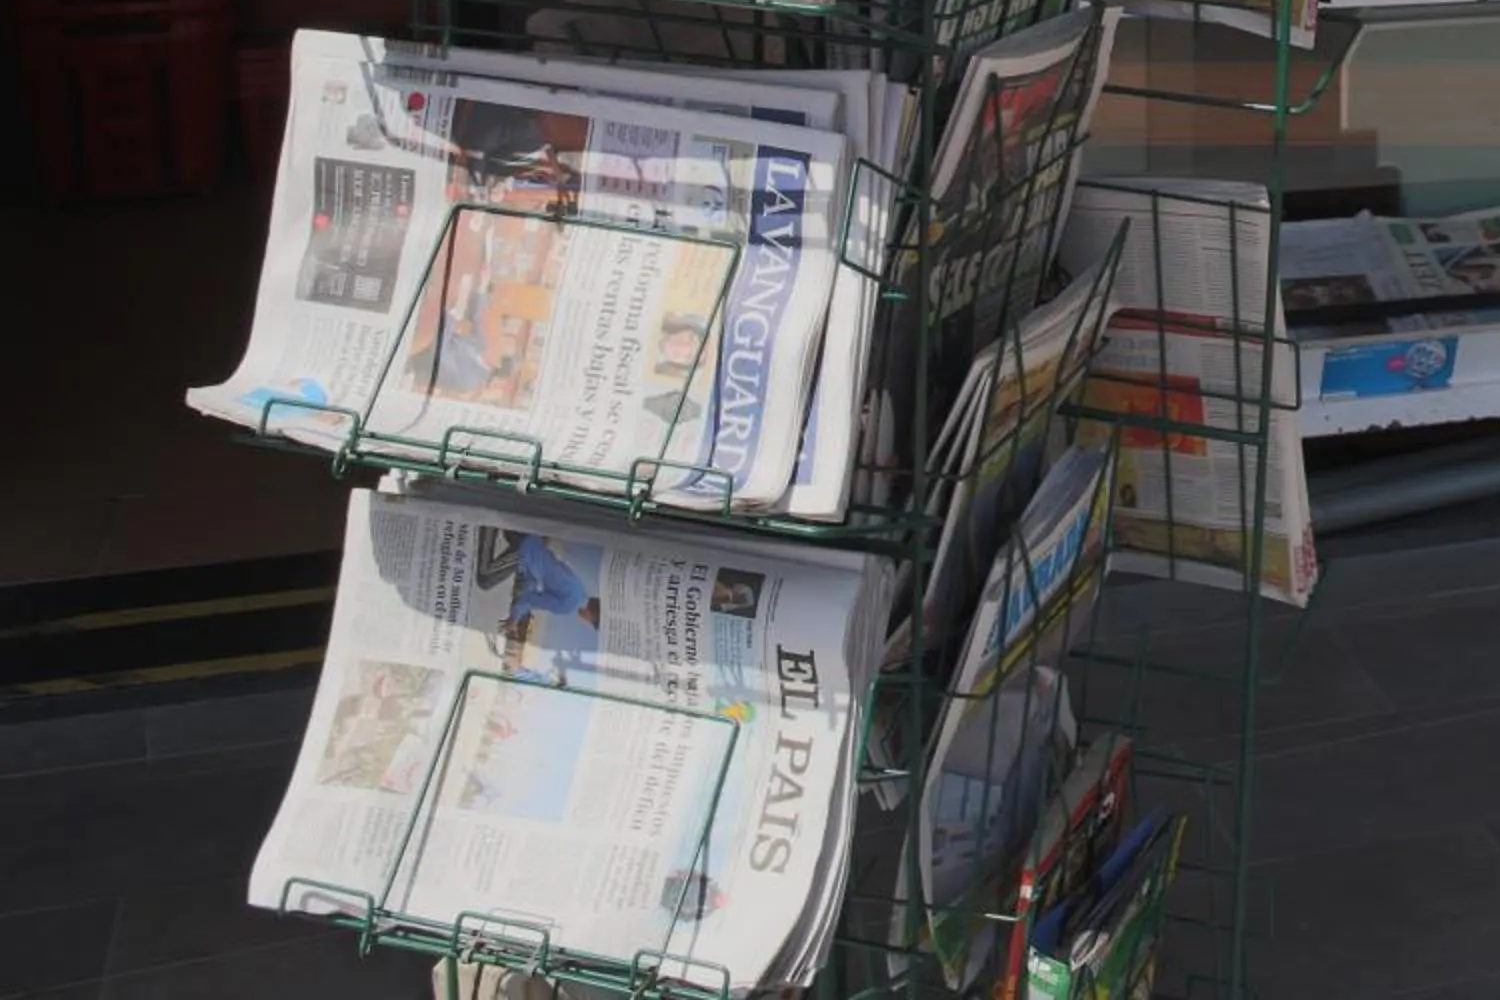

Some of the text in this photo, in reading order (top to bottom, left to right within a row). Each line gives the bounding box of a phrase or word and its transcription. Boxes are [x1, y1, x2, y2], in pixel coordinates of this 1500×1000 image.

[763, 159, 800, 217] LA
[595, 269, 628, 338] rentas
[583, 344, 615, 402] bajas
[614, 339, 642, 396] fiscal
[663, 575, 680, 645] arriesga
[682, 588, 704, 665] Gobierno
[775, 644, 819, 719] EL
